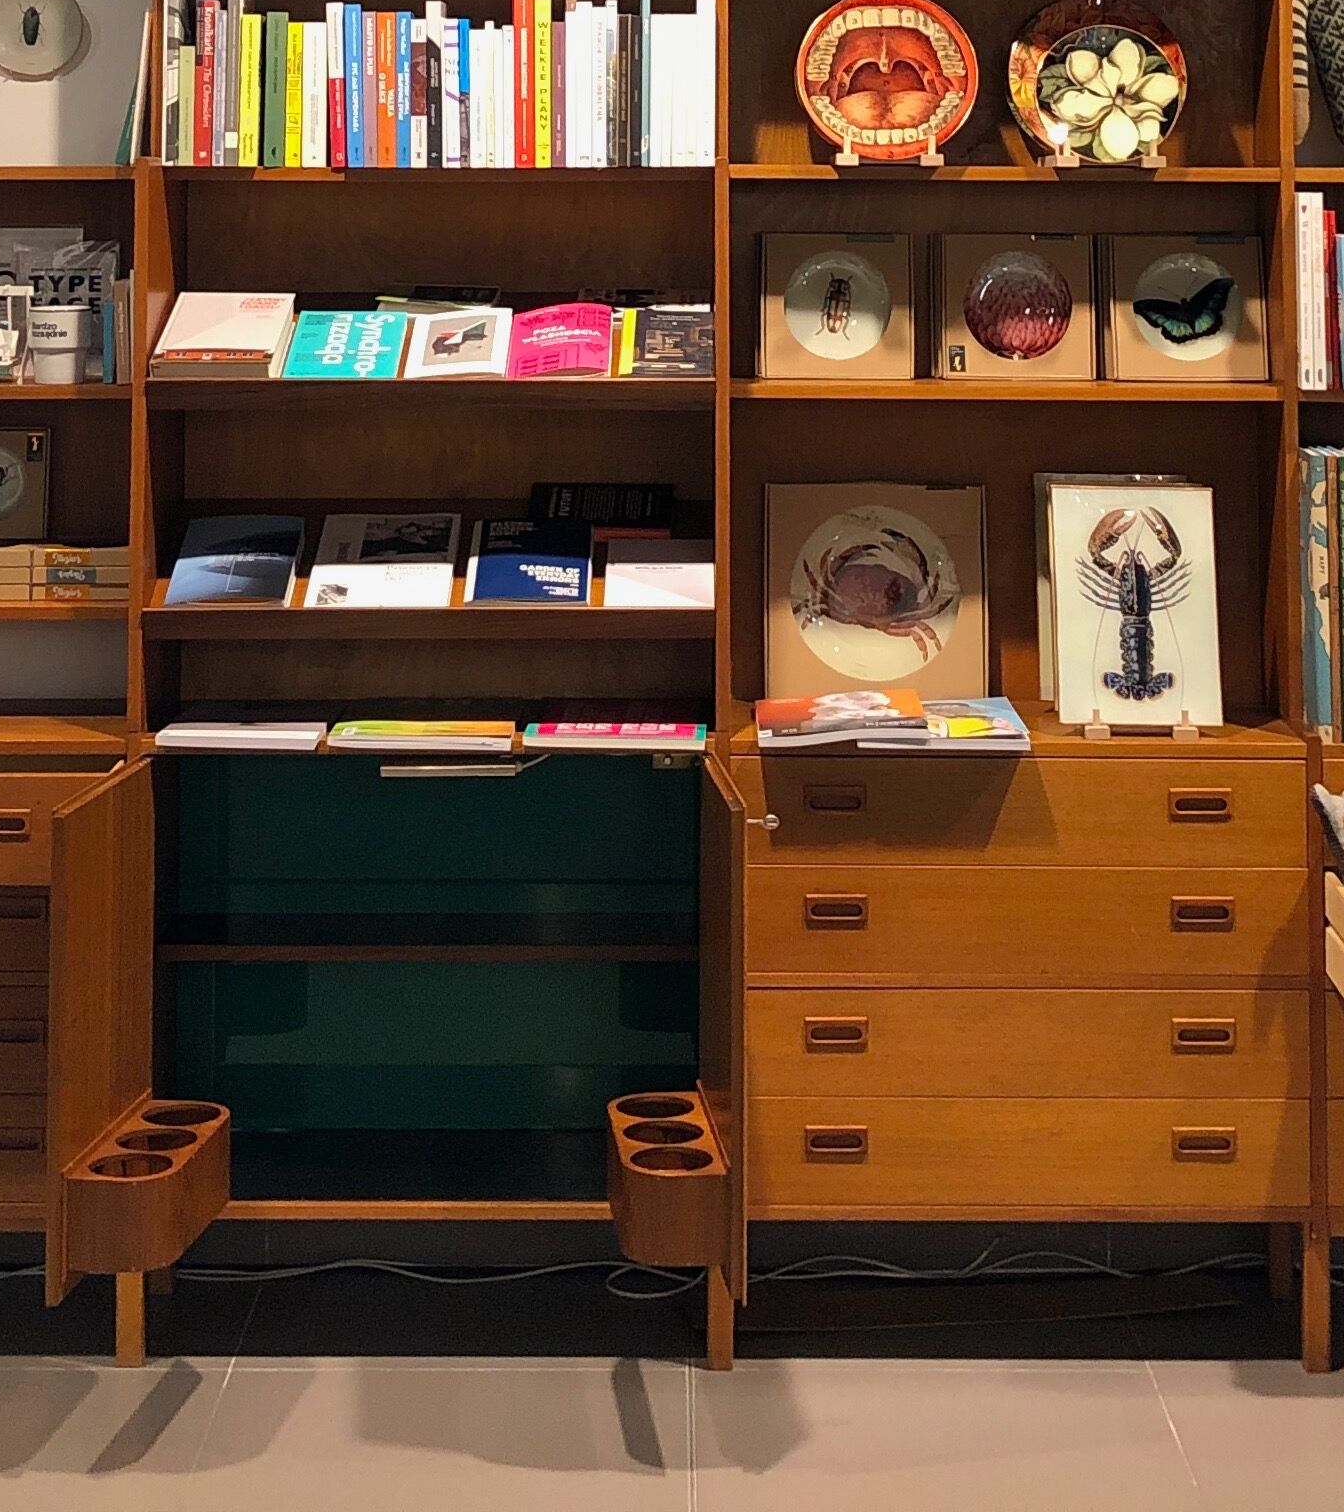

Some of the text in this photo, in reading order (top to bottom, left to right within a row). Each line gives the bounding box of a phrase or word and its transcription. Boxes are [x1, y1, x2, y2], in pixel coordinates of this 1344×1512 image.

[203, 7, 214, 128] Kronikarki The Chroniclers
[540, 22, 548, 130] WIELKIE PLANY
[28, 276, 101, 292] TYPE
[533, 324, 567, 334] POZA
